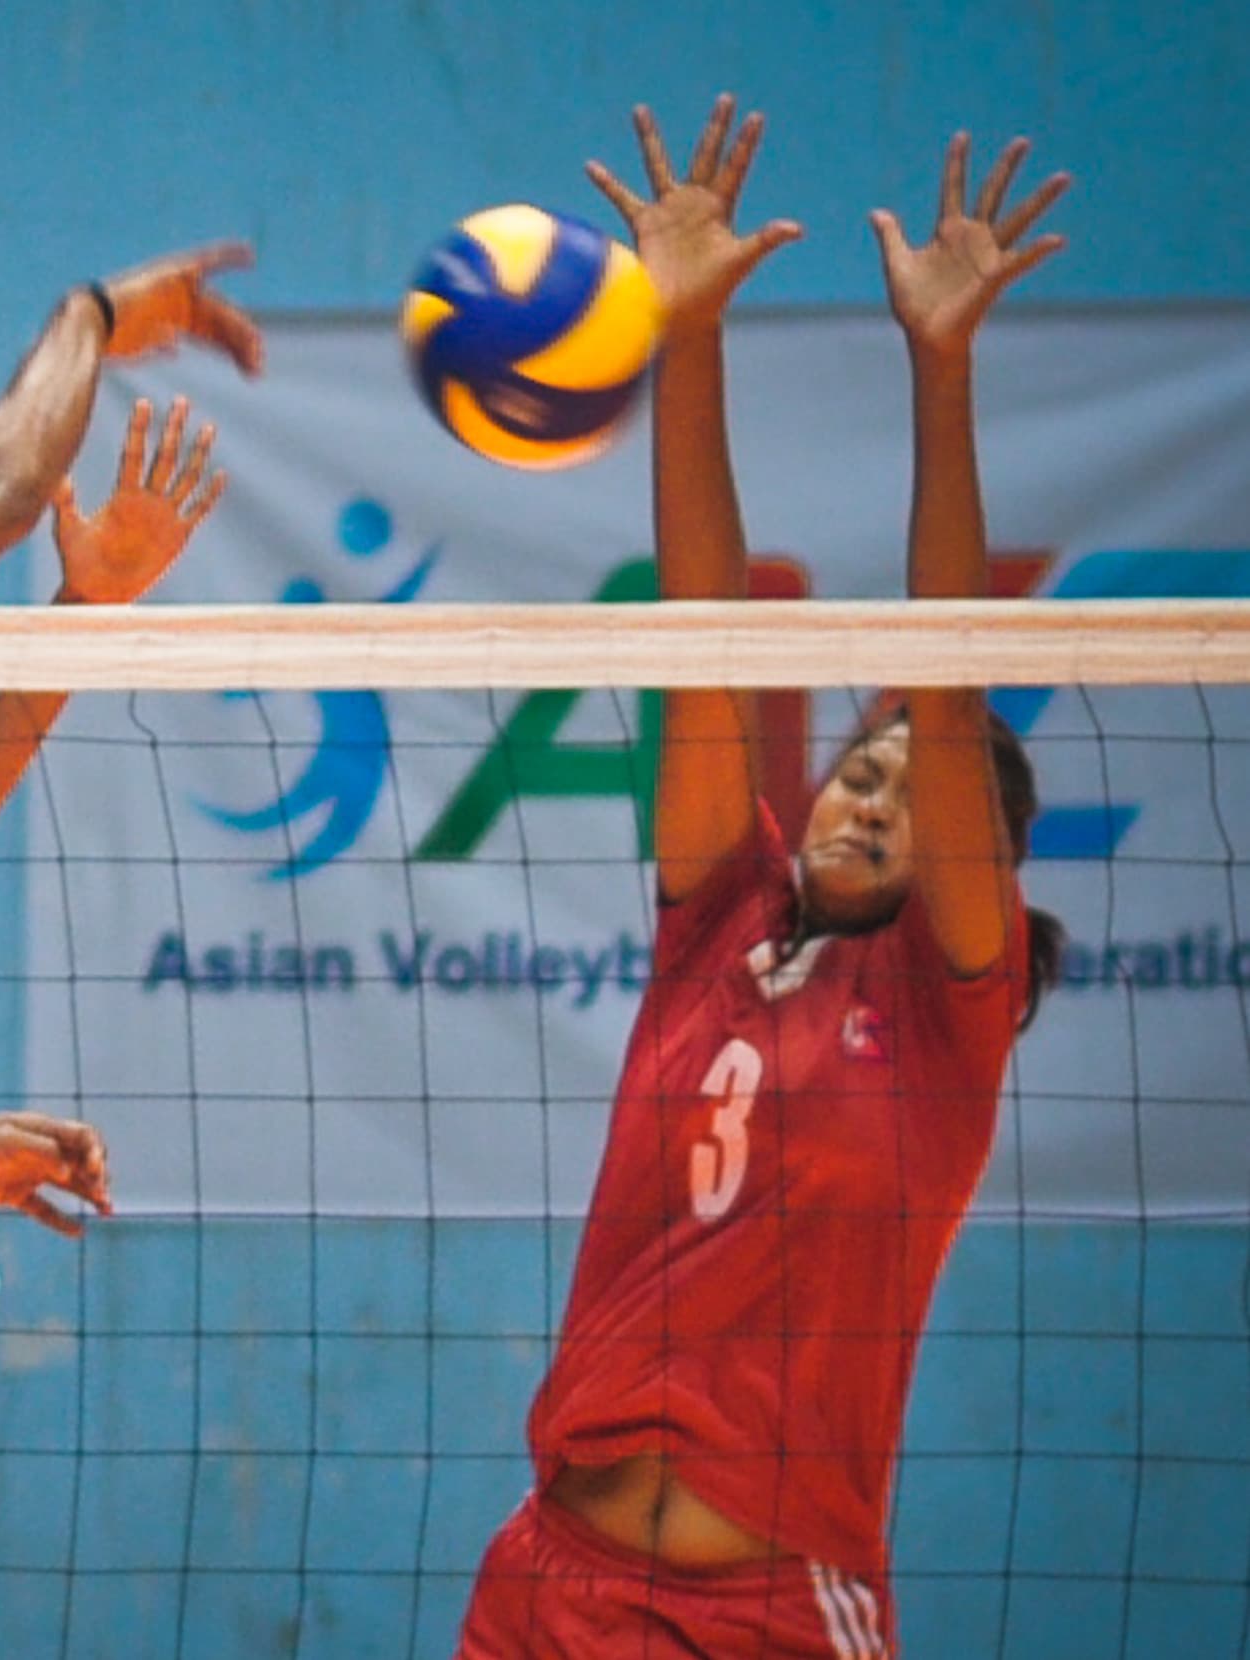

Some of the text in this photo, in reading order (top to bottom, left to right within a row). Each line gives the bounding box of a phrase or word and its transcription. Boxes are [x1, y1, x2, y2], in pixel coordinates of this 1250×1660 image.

[145, 929, 355, 994] Asian
[378, 929, 652, 1009] Volleyb
[690, 1038, 763, 1222] 3
